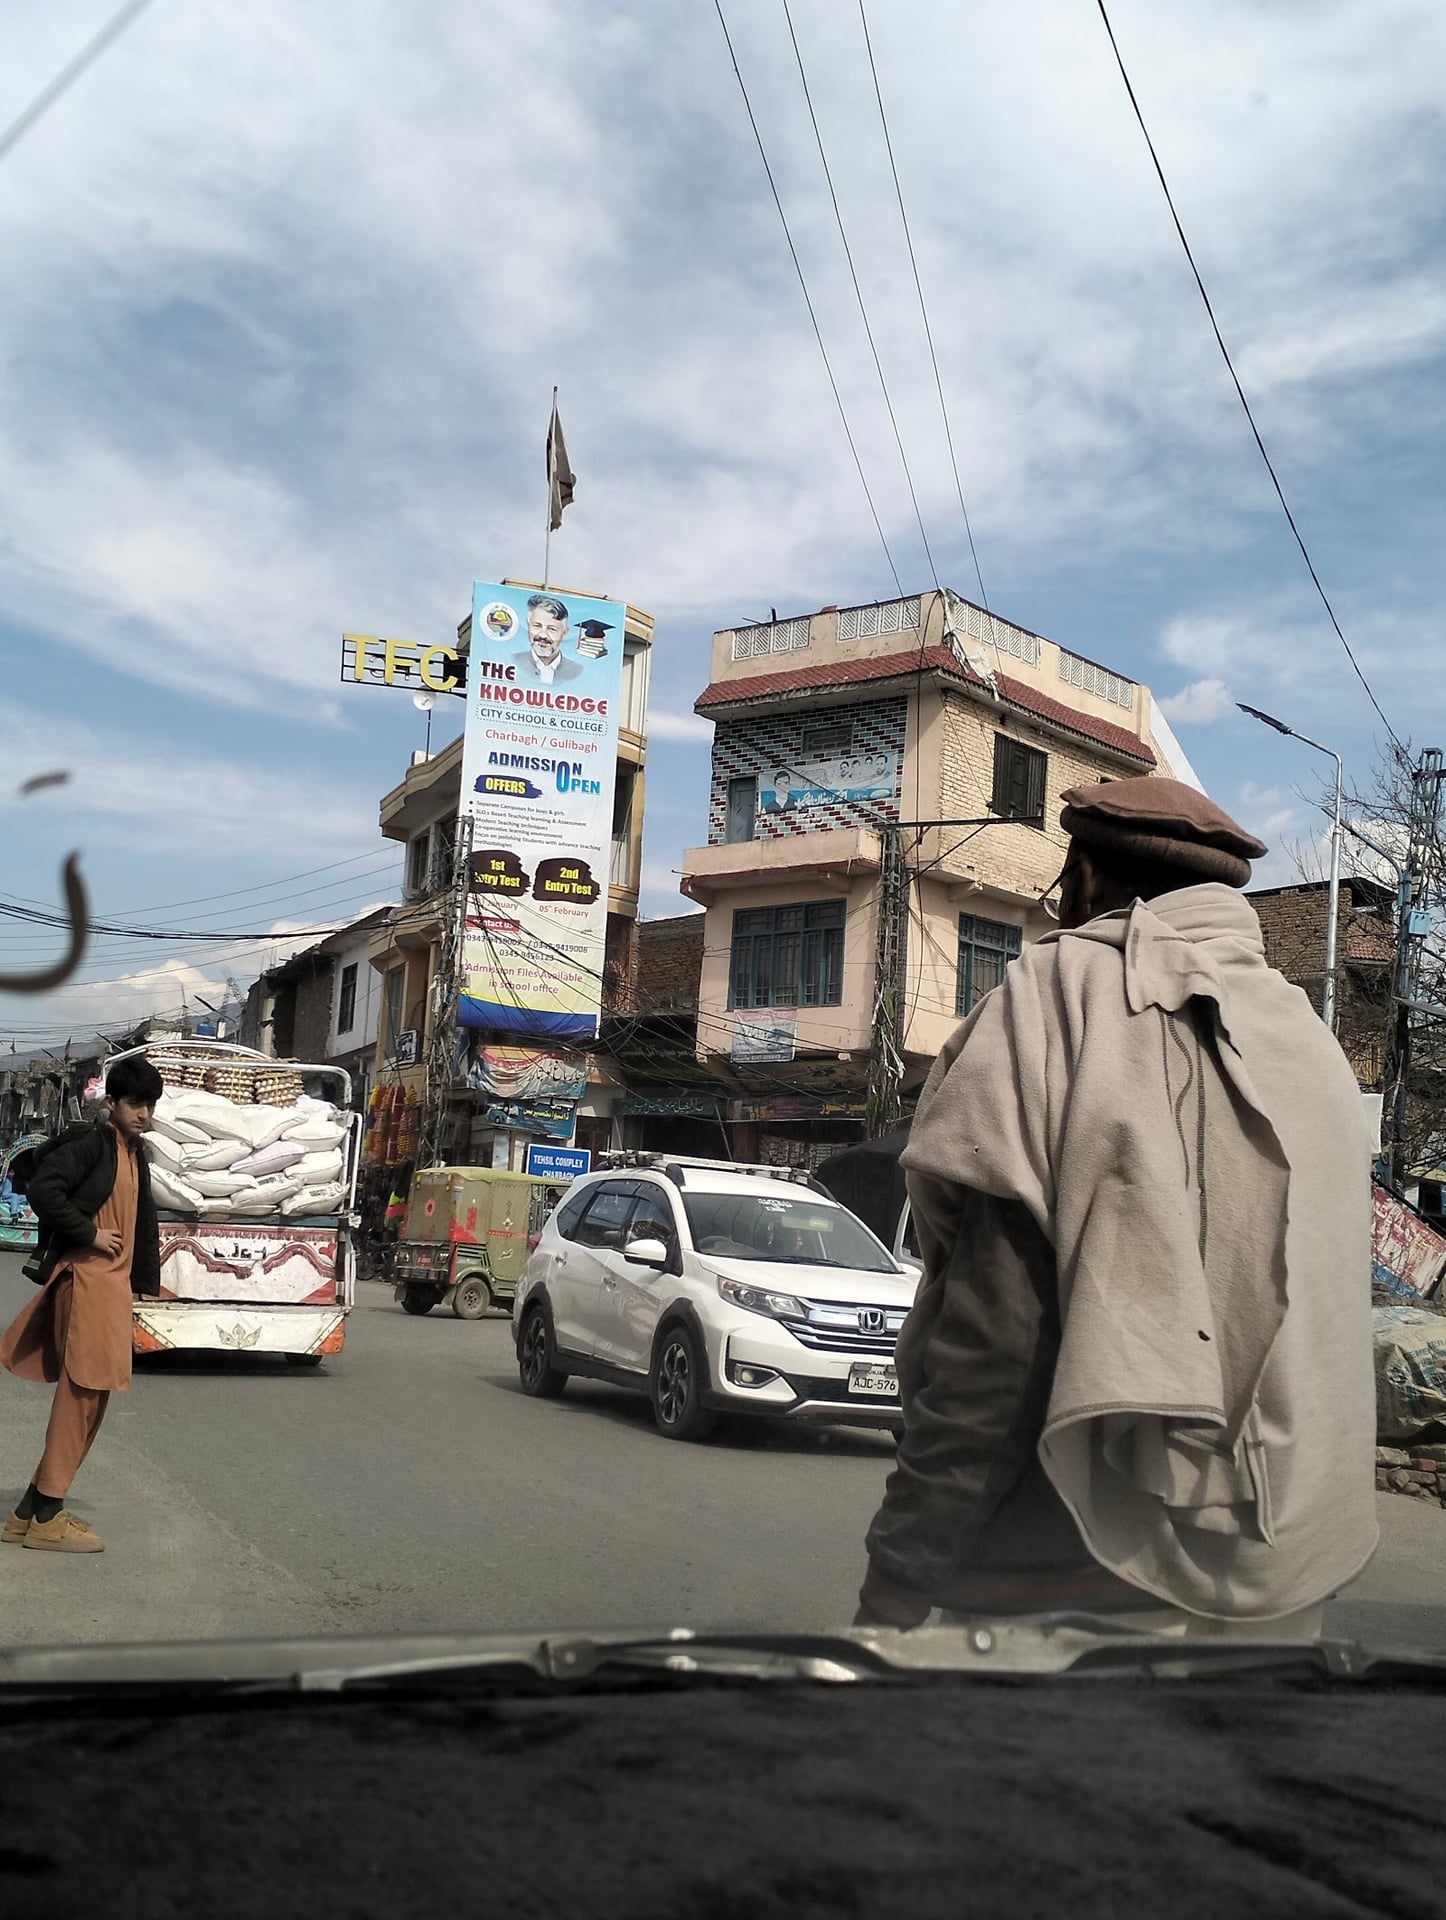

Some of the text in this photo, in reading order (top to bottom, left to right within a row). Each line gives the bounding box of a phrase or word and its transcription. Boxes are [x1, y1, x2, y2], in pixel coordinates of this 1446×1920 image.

[343, 633, 459, 691] TFC
[480, 661, 515, 680] THE
[480, 683, 608, 715] KNOWLEDGE
[481, 708, 603, 733] CITY SCHOOL & COLLEGE
[485, 729, 538, 746] Charbagh
[550, 737, 598, 754] Gulibagh
[488, 751, 582, 783] ADMISSION
[556, 761, 600, 793] OPEN
[485, 777, 526, 794] OFFERS
[477, 800, 499, 808] Separate
[498, 820, 520, 828] Teaching
[521, 823, 548, 831] techniques
[508, 813, 529, 821] Teaching
[531, 816, 551, 824] learning
[558, 819, 586, 827] Assessment
[509, 827, 529, 836] learning
[490, 859, 505, 871] 1st
[560, 867, 579, 879] 2nd
[500, 875, 520, 887] Test
[545, 880, 592, 895] Entry Test
[554, 906, 589, 919] February
[467, 963, 583, 983] Admission Files Available
[500, 981, 531, 991] school
[533, 984, 559, 994] office
[534, 1154, 583, 1169] TEHSIL COMPLEX
[853, 1377, 896, 1391] AJC-576
